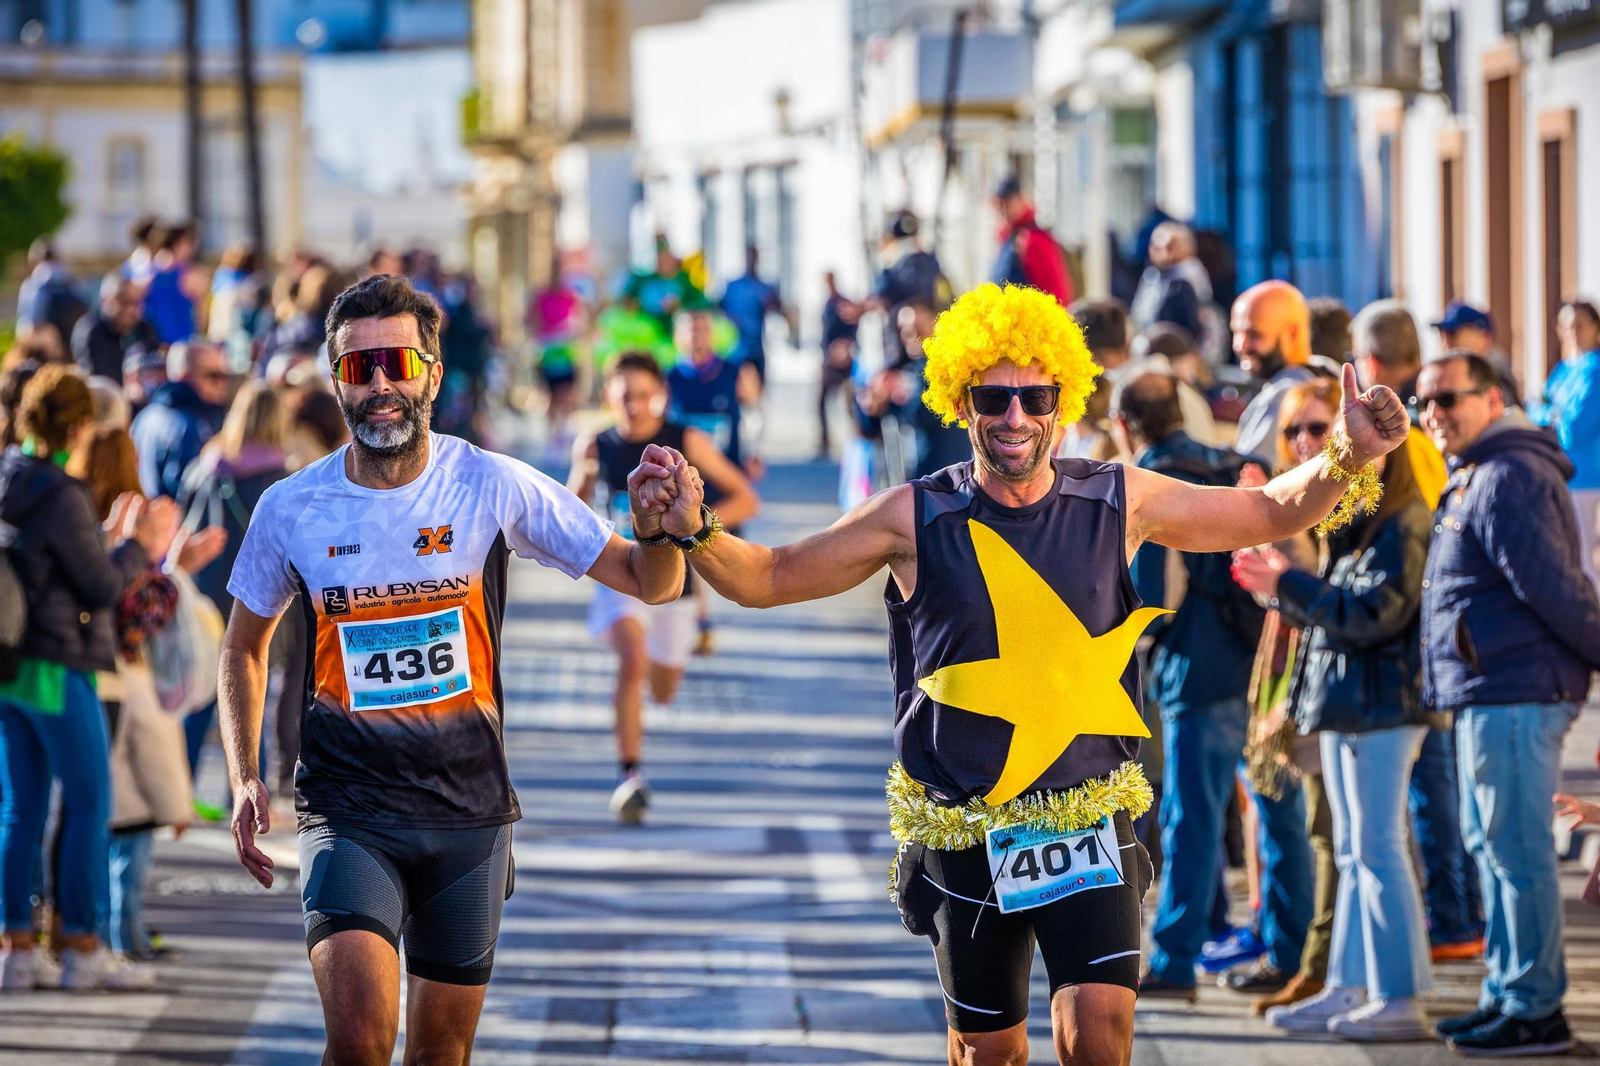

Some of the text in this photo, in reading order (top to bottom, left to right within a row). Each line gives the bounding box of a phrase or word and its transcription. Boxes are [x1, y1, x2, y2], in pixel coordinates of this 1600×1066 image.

[353, 575, 469, 600] RUBYSAN
[354, 591, 469, 610] industria agrícola automoción
[345, 630, 357, 648] X
[363, 642, 455, 683] 436
[390, 689, 431, 702] cajasur
[1010, 835, 1100, 882] 401
[1039, 881, 1077, 900] cajasur
